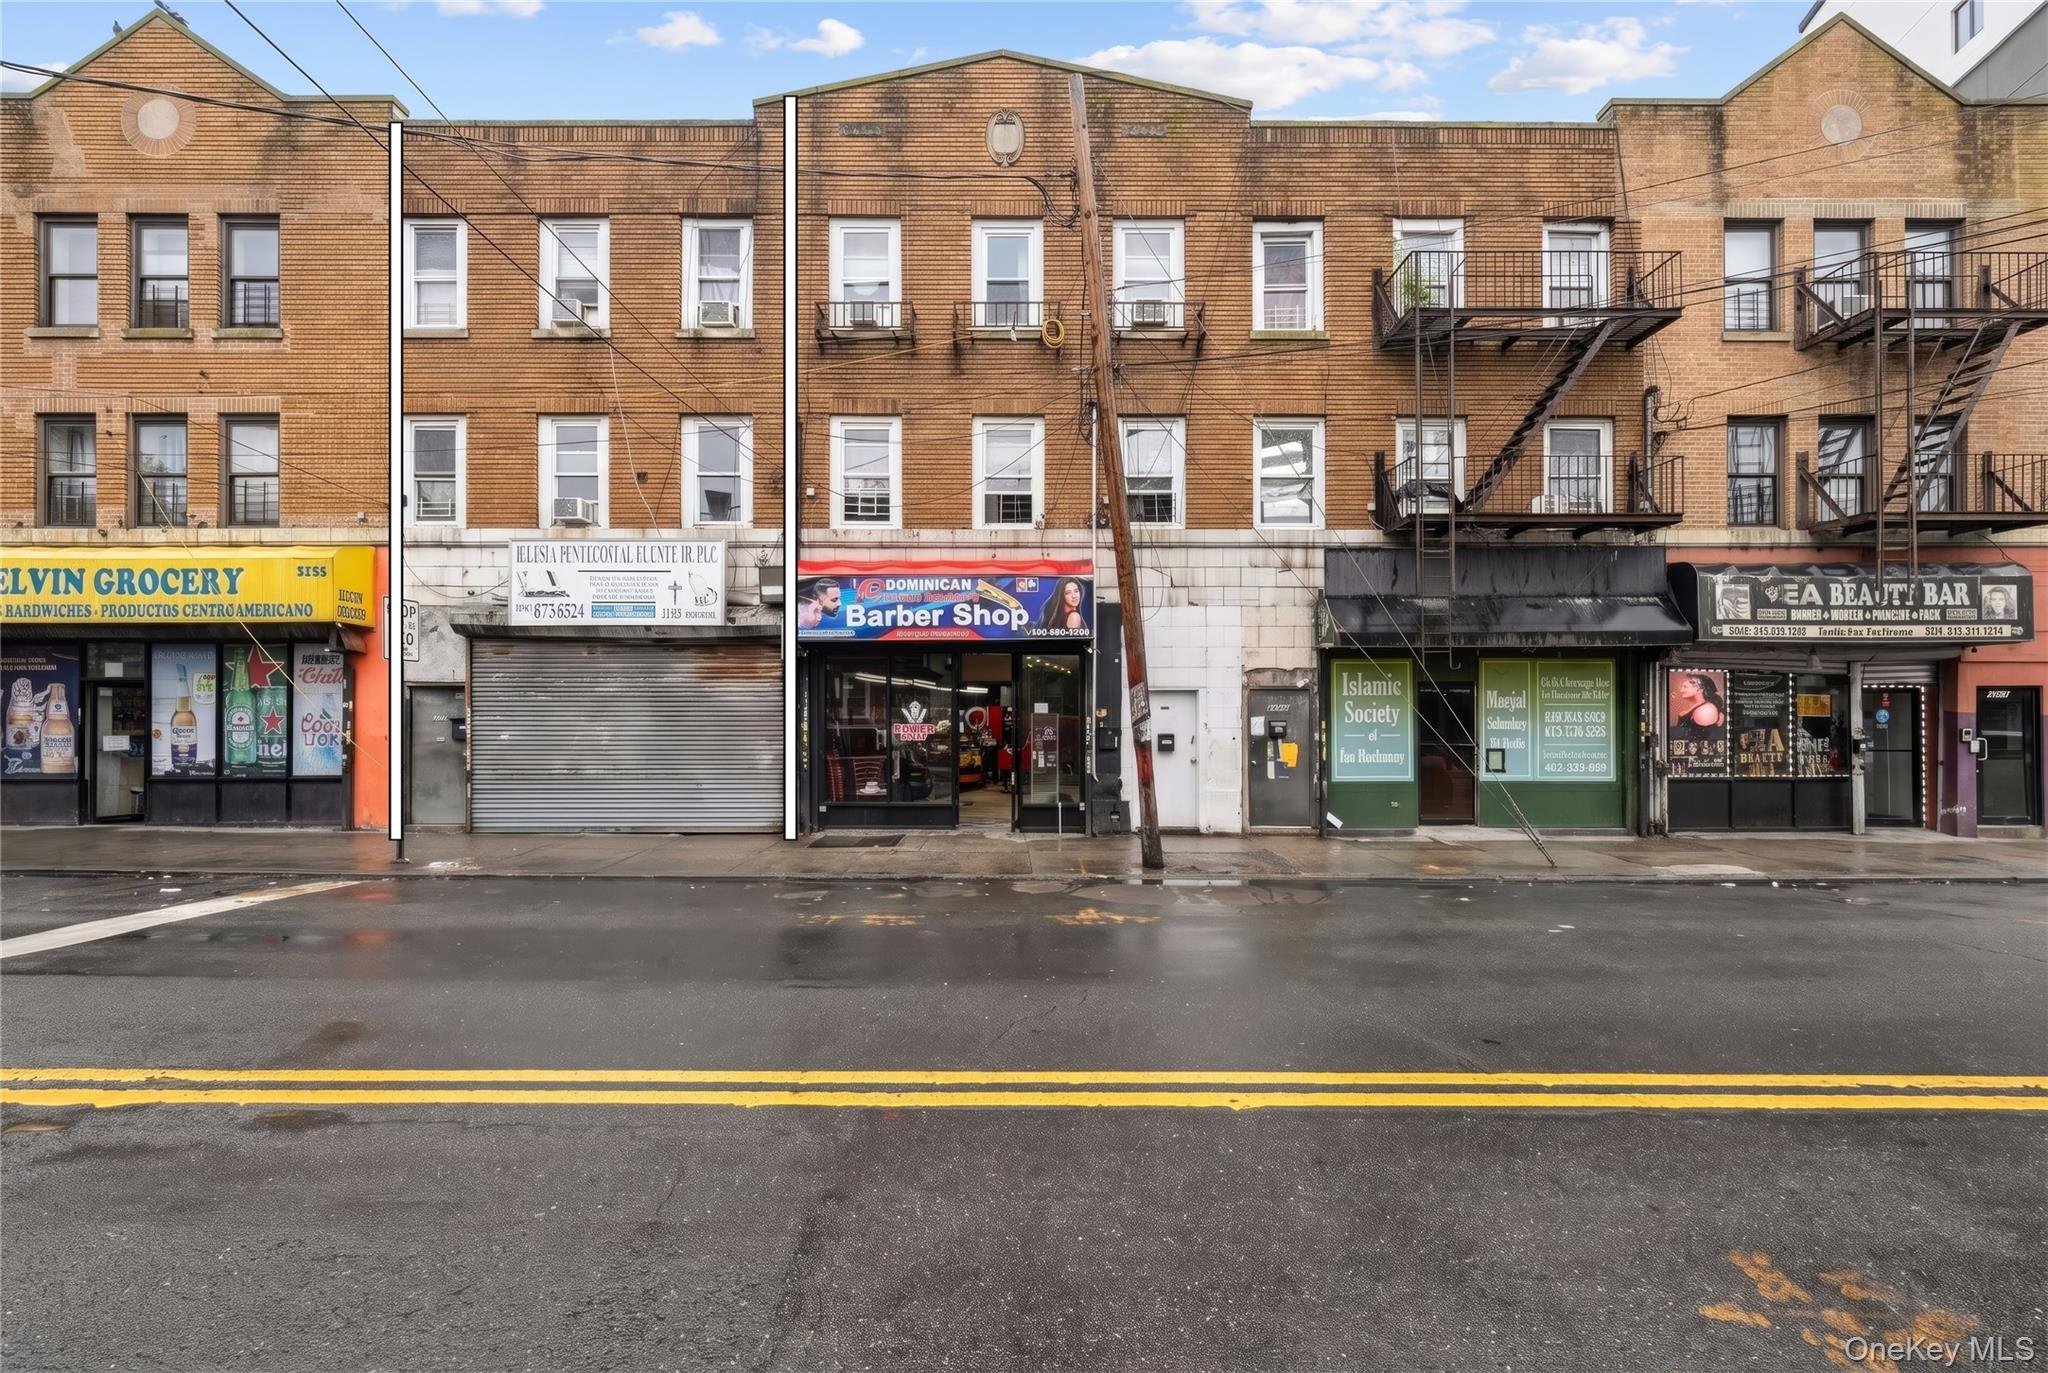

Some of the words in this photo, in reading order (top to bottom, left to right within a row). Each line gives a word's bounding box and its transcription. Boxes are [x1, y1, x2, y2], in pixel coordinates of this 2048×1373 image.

[94, 567, 244, 596] GROCERY
[885, 578, 972, 591] DOMINICAN
[1829, 583, 1916, 607] BEAUTY
[1923, 583, 1971, 606] BAR
[846, 604, 944, 627] Barber
[953, 603, 1030, 631] Shop
[1342, 672, 1402, 696] Islamic
[1344, 700, 1401, 727] Society
